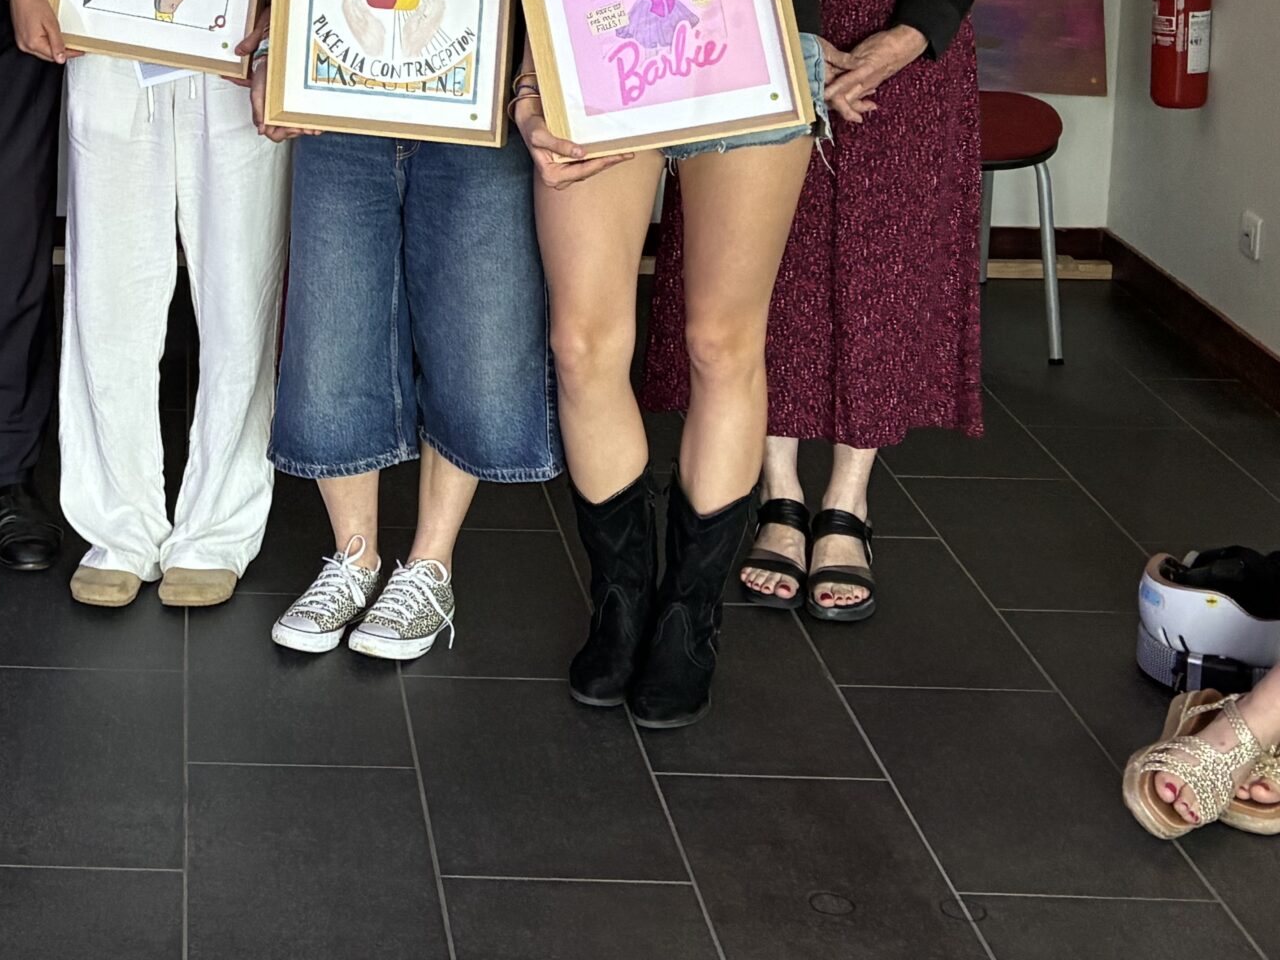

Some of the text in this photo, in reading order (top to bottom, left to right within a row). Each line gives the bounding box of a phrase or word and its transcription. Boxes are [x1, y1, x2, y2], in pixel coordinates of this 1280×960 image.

[313, 13, 343, 53] PLACE
[370, 27, 476, 79] CONTRACEPTION
[315, 53, 466, 97] MASCULINE
[608, 24, 727, 106] Barbie
